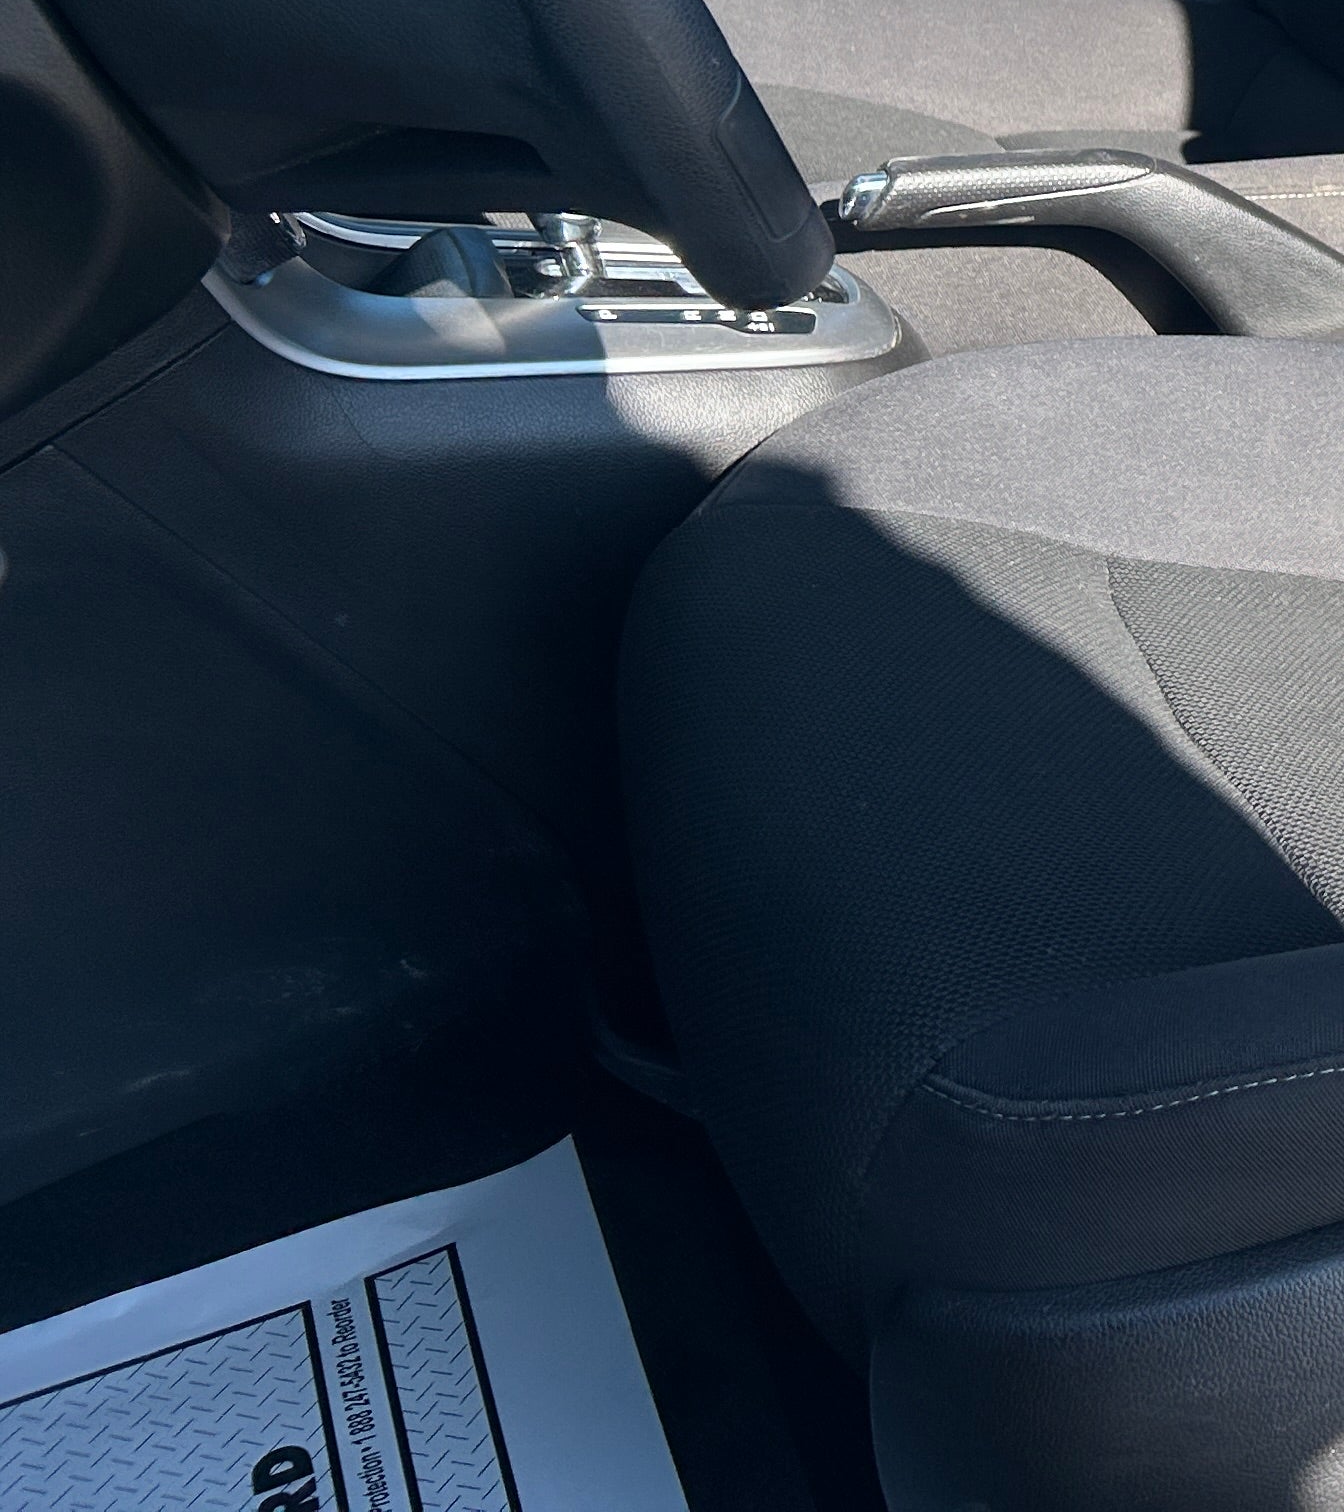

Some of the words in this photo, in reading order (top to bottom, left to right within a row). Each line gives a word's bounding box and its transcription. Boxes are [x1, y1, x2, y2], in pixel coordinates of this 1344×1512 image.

[326, 1297, 357, 1347] Reorder
[336, 1345, 360, 1358] to
[346, 1408, 376, 1437] 888
[352, 1434, 377, 1446] 1
